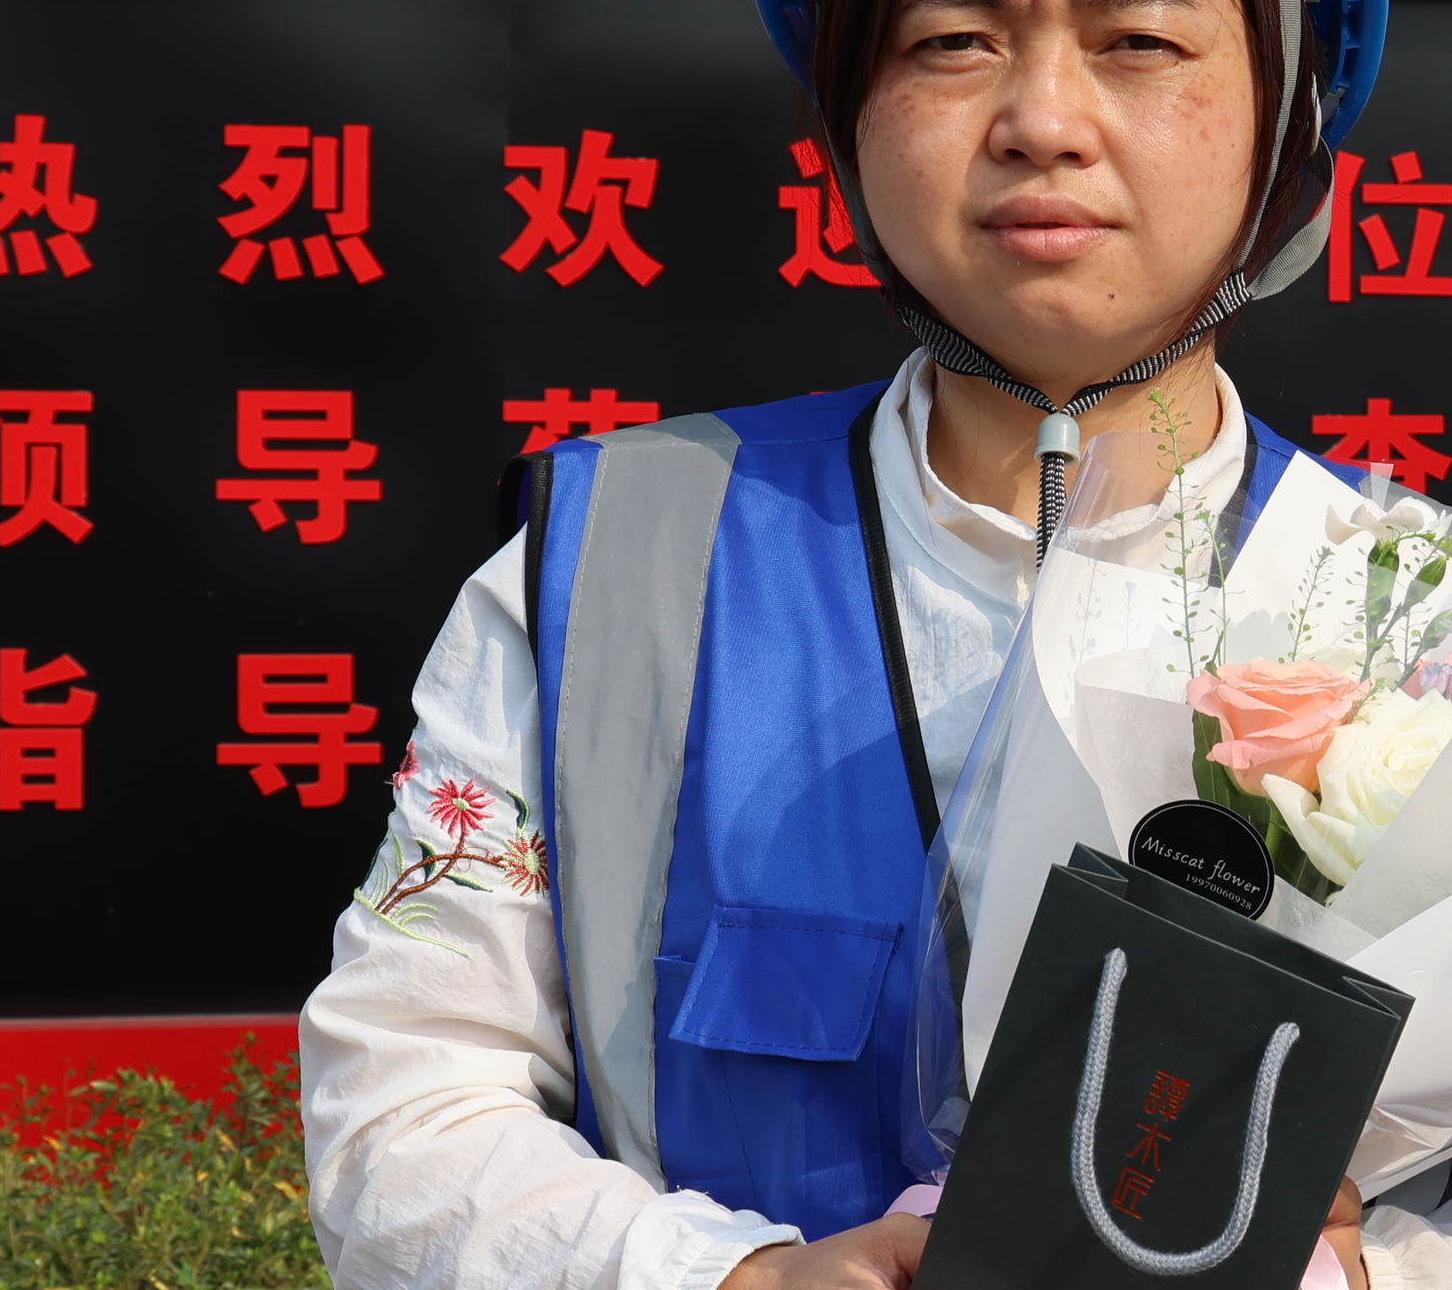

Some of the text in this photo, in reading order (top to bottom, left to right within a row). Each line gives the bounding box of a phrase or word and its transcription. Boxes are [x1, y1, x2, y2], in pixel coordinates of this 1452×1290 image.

[1141, 836, 1260, 896] Misscat flower
[1185, 873, 1253, 911] 19970060928
